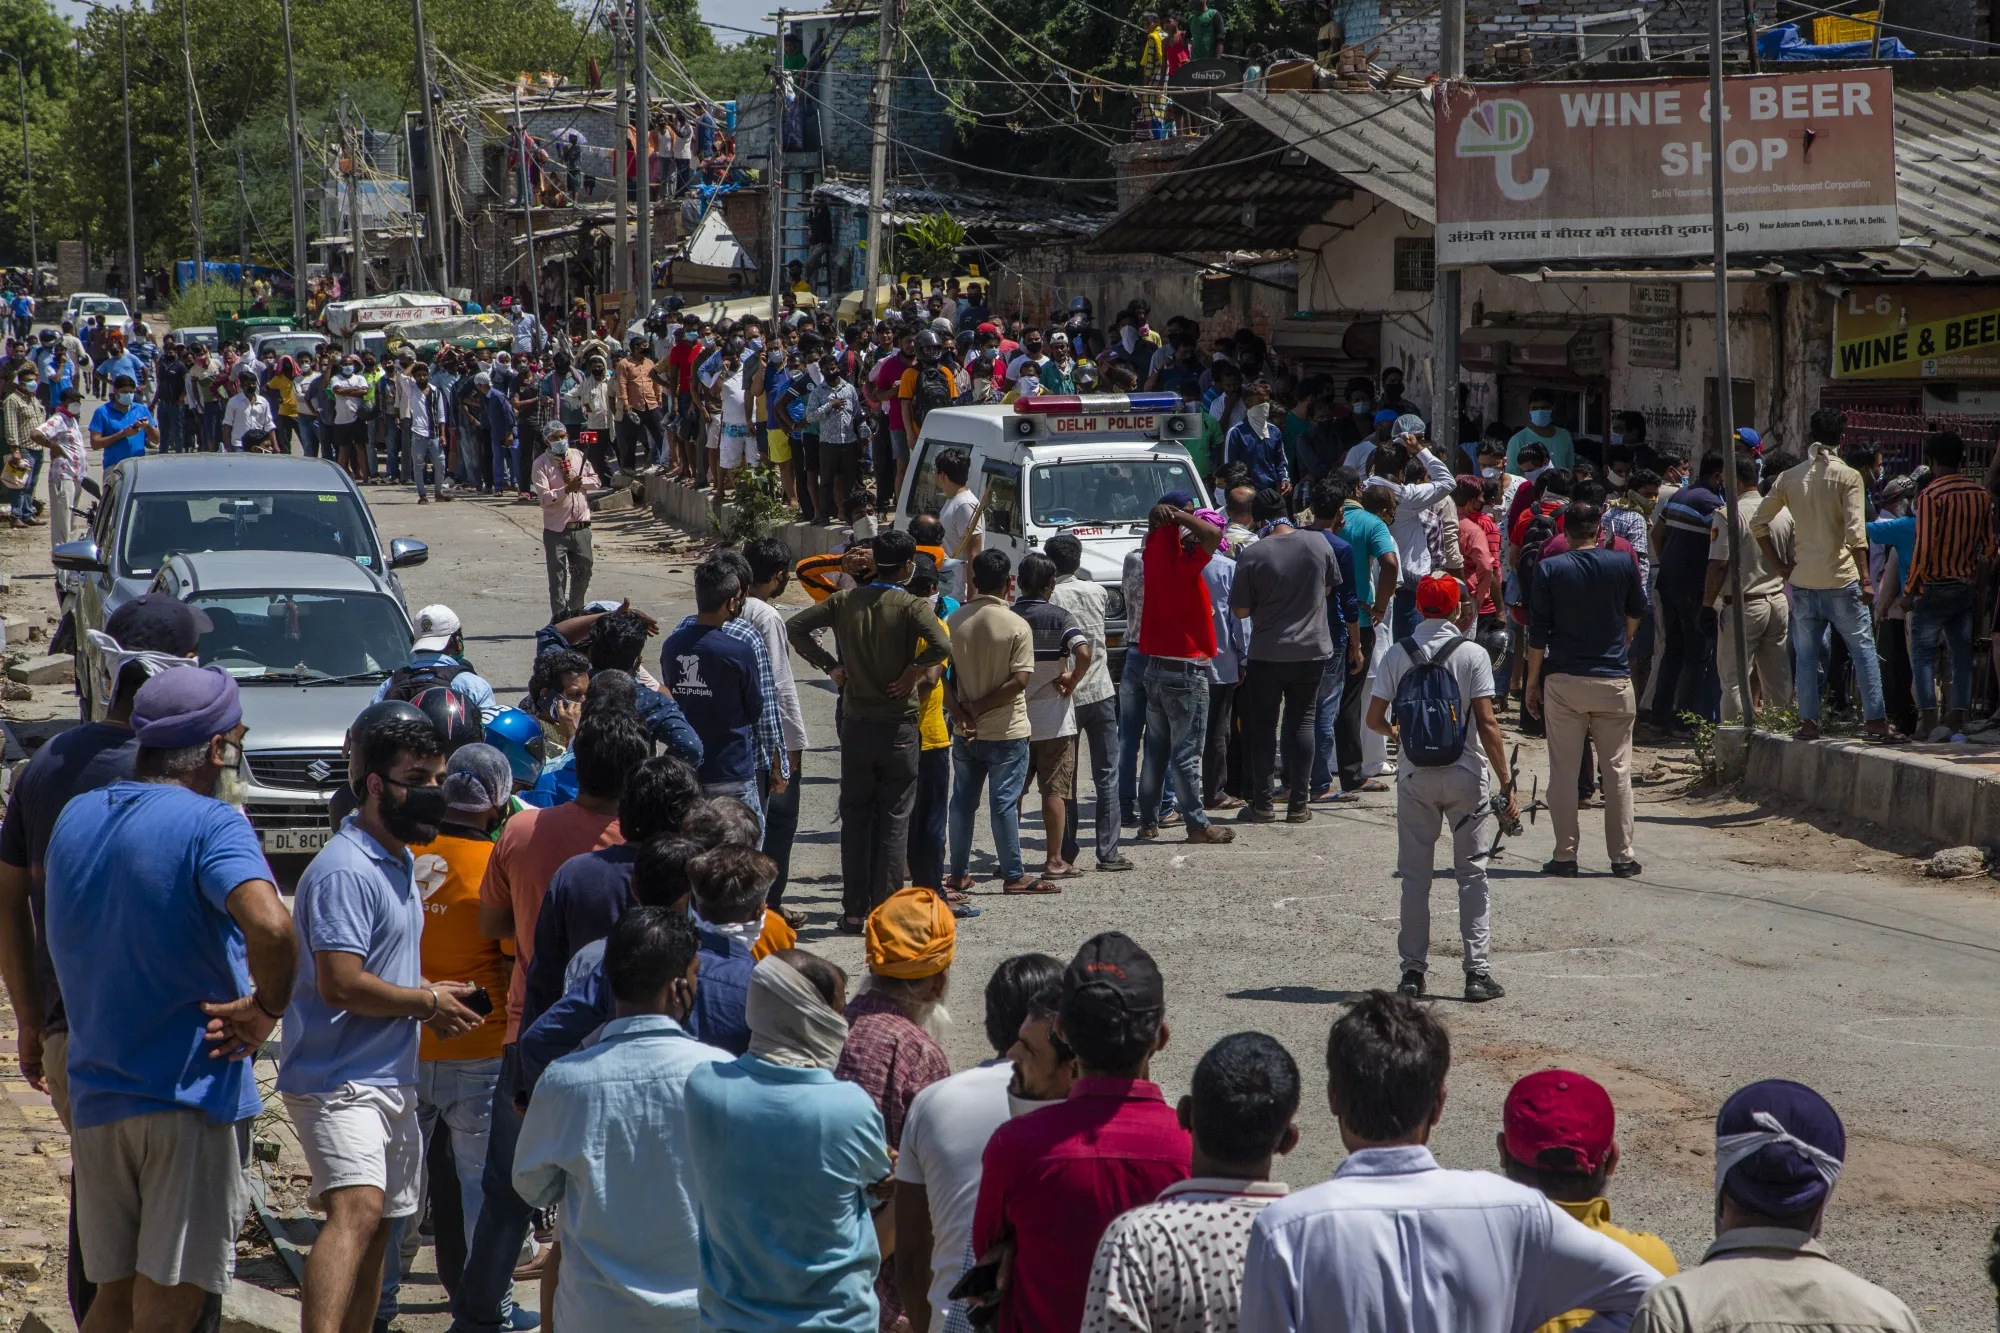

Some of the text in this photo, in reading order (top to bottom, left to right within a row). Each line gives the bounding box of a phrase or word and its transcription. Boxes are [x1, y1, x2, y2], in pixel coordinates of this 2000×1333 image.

[1191, 70, 1225, 80] dishtv
[1560, 82, 1874, 128] WINE & BEER
[1651, 188, 1672, 199] Delhi
[1674, 186, 1705, 198] Tourism
[1772, 181, 1823, 193] Development
[1824, 179, 1872, 190] Corporation
[1759, 215, 1887, 230] Near Ashram Chowk, S. N. Puri, N. Delhi.
[1448, 229, 1495, 243] अंग्रेजी
[1499, 230, 1537, 241] शराब
[1541, 229, 1552, 239] व
[1556, 226, 1592, 239] बीयर
[1596, 226, 1616, 238] की
[1620, 224, 1674, 237] सरकारी
[1726, 223, 1750, 234] L-6)
[1654, 288, 1670, 302] BEER
[1848, 294, 1892, 315] L-6
[1840, 311, 2000, 373] WINE & BEE
[1057, 416, 1153, 432] DELHI POLICE
[1073, 528, 1103, 536] DELHI
[276, 834, 294, 848] DL
